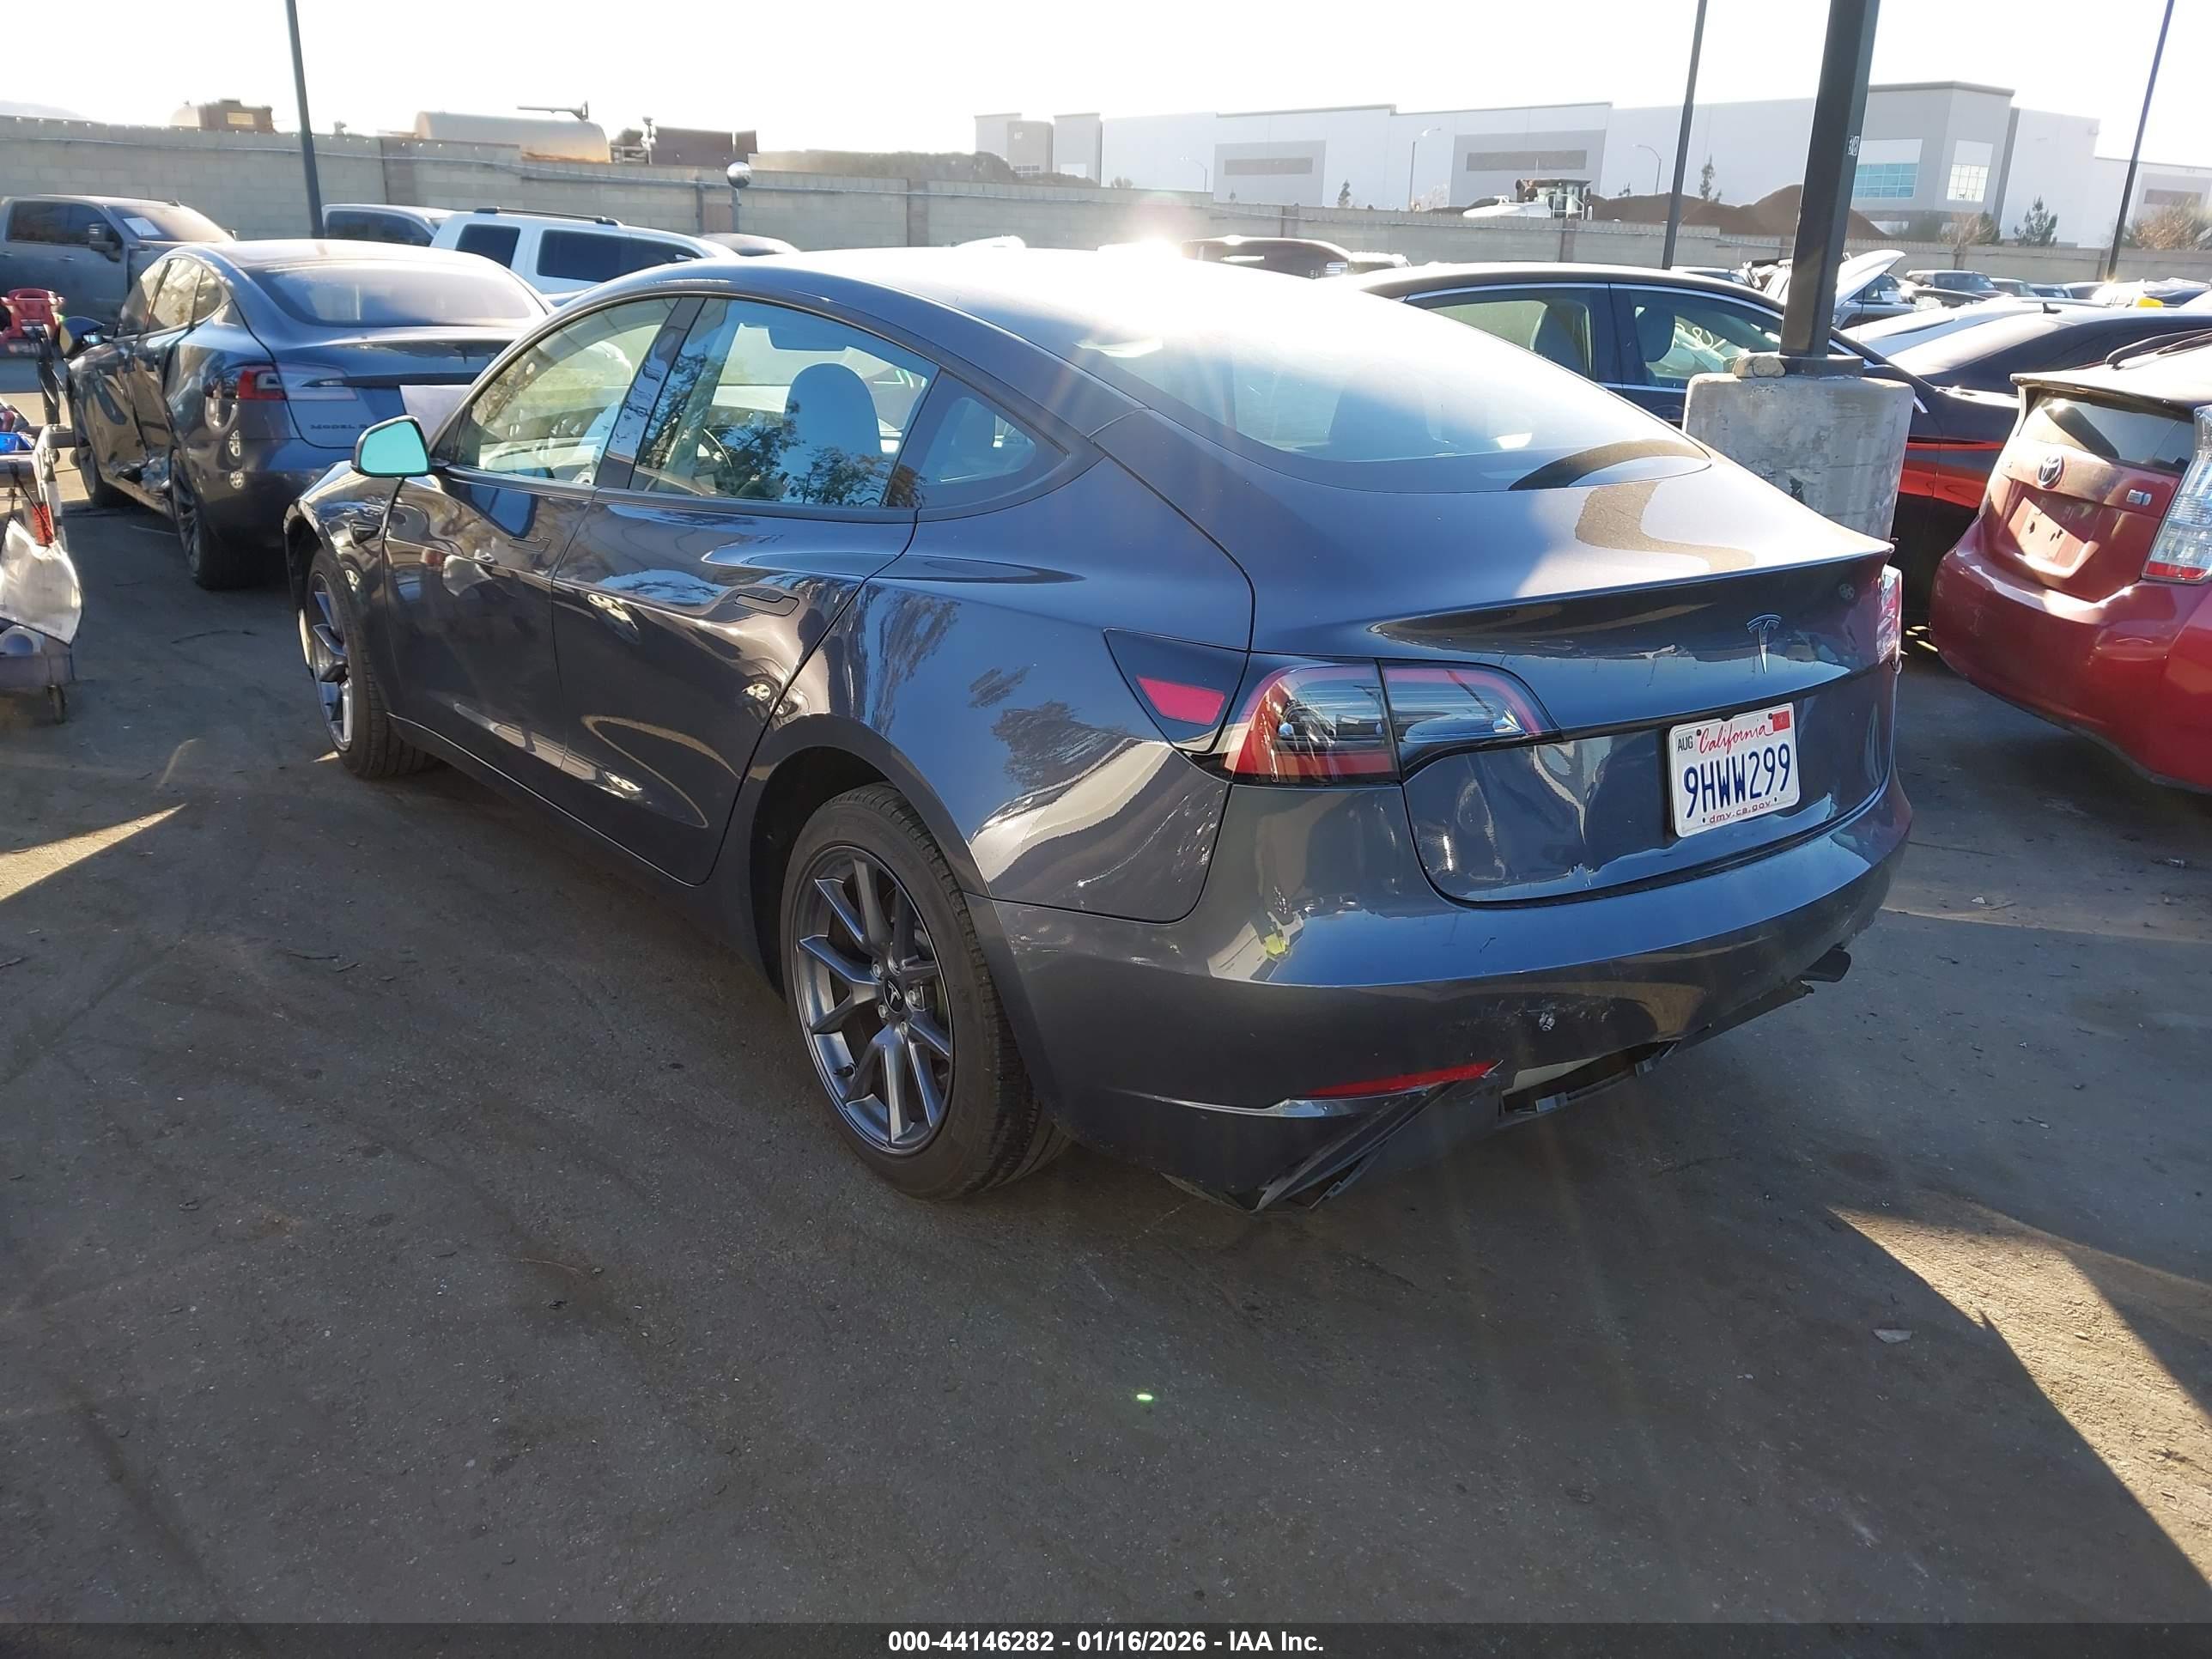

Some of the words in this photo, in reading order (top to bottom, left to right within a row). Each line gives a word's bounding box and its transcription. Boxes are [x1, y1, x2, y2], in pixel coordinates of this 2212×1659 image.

[1677, 735, 1693, 752] AUG
[1698, 722, 1773, 755] California
[1683, 743, 1791, 818] 9HWW299
[1709, 800, 1771, 823] dmv.ca.gov
